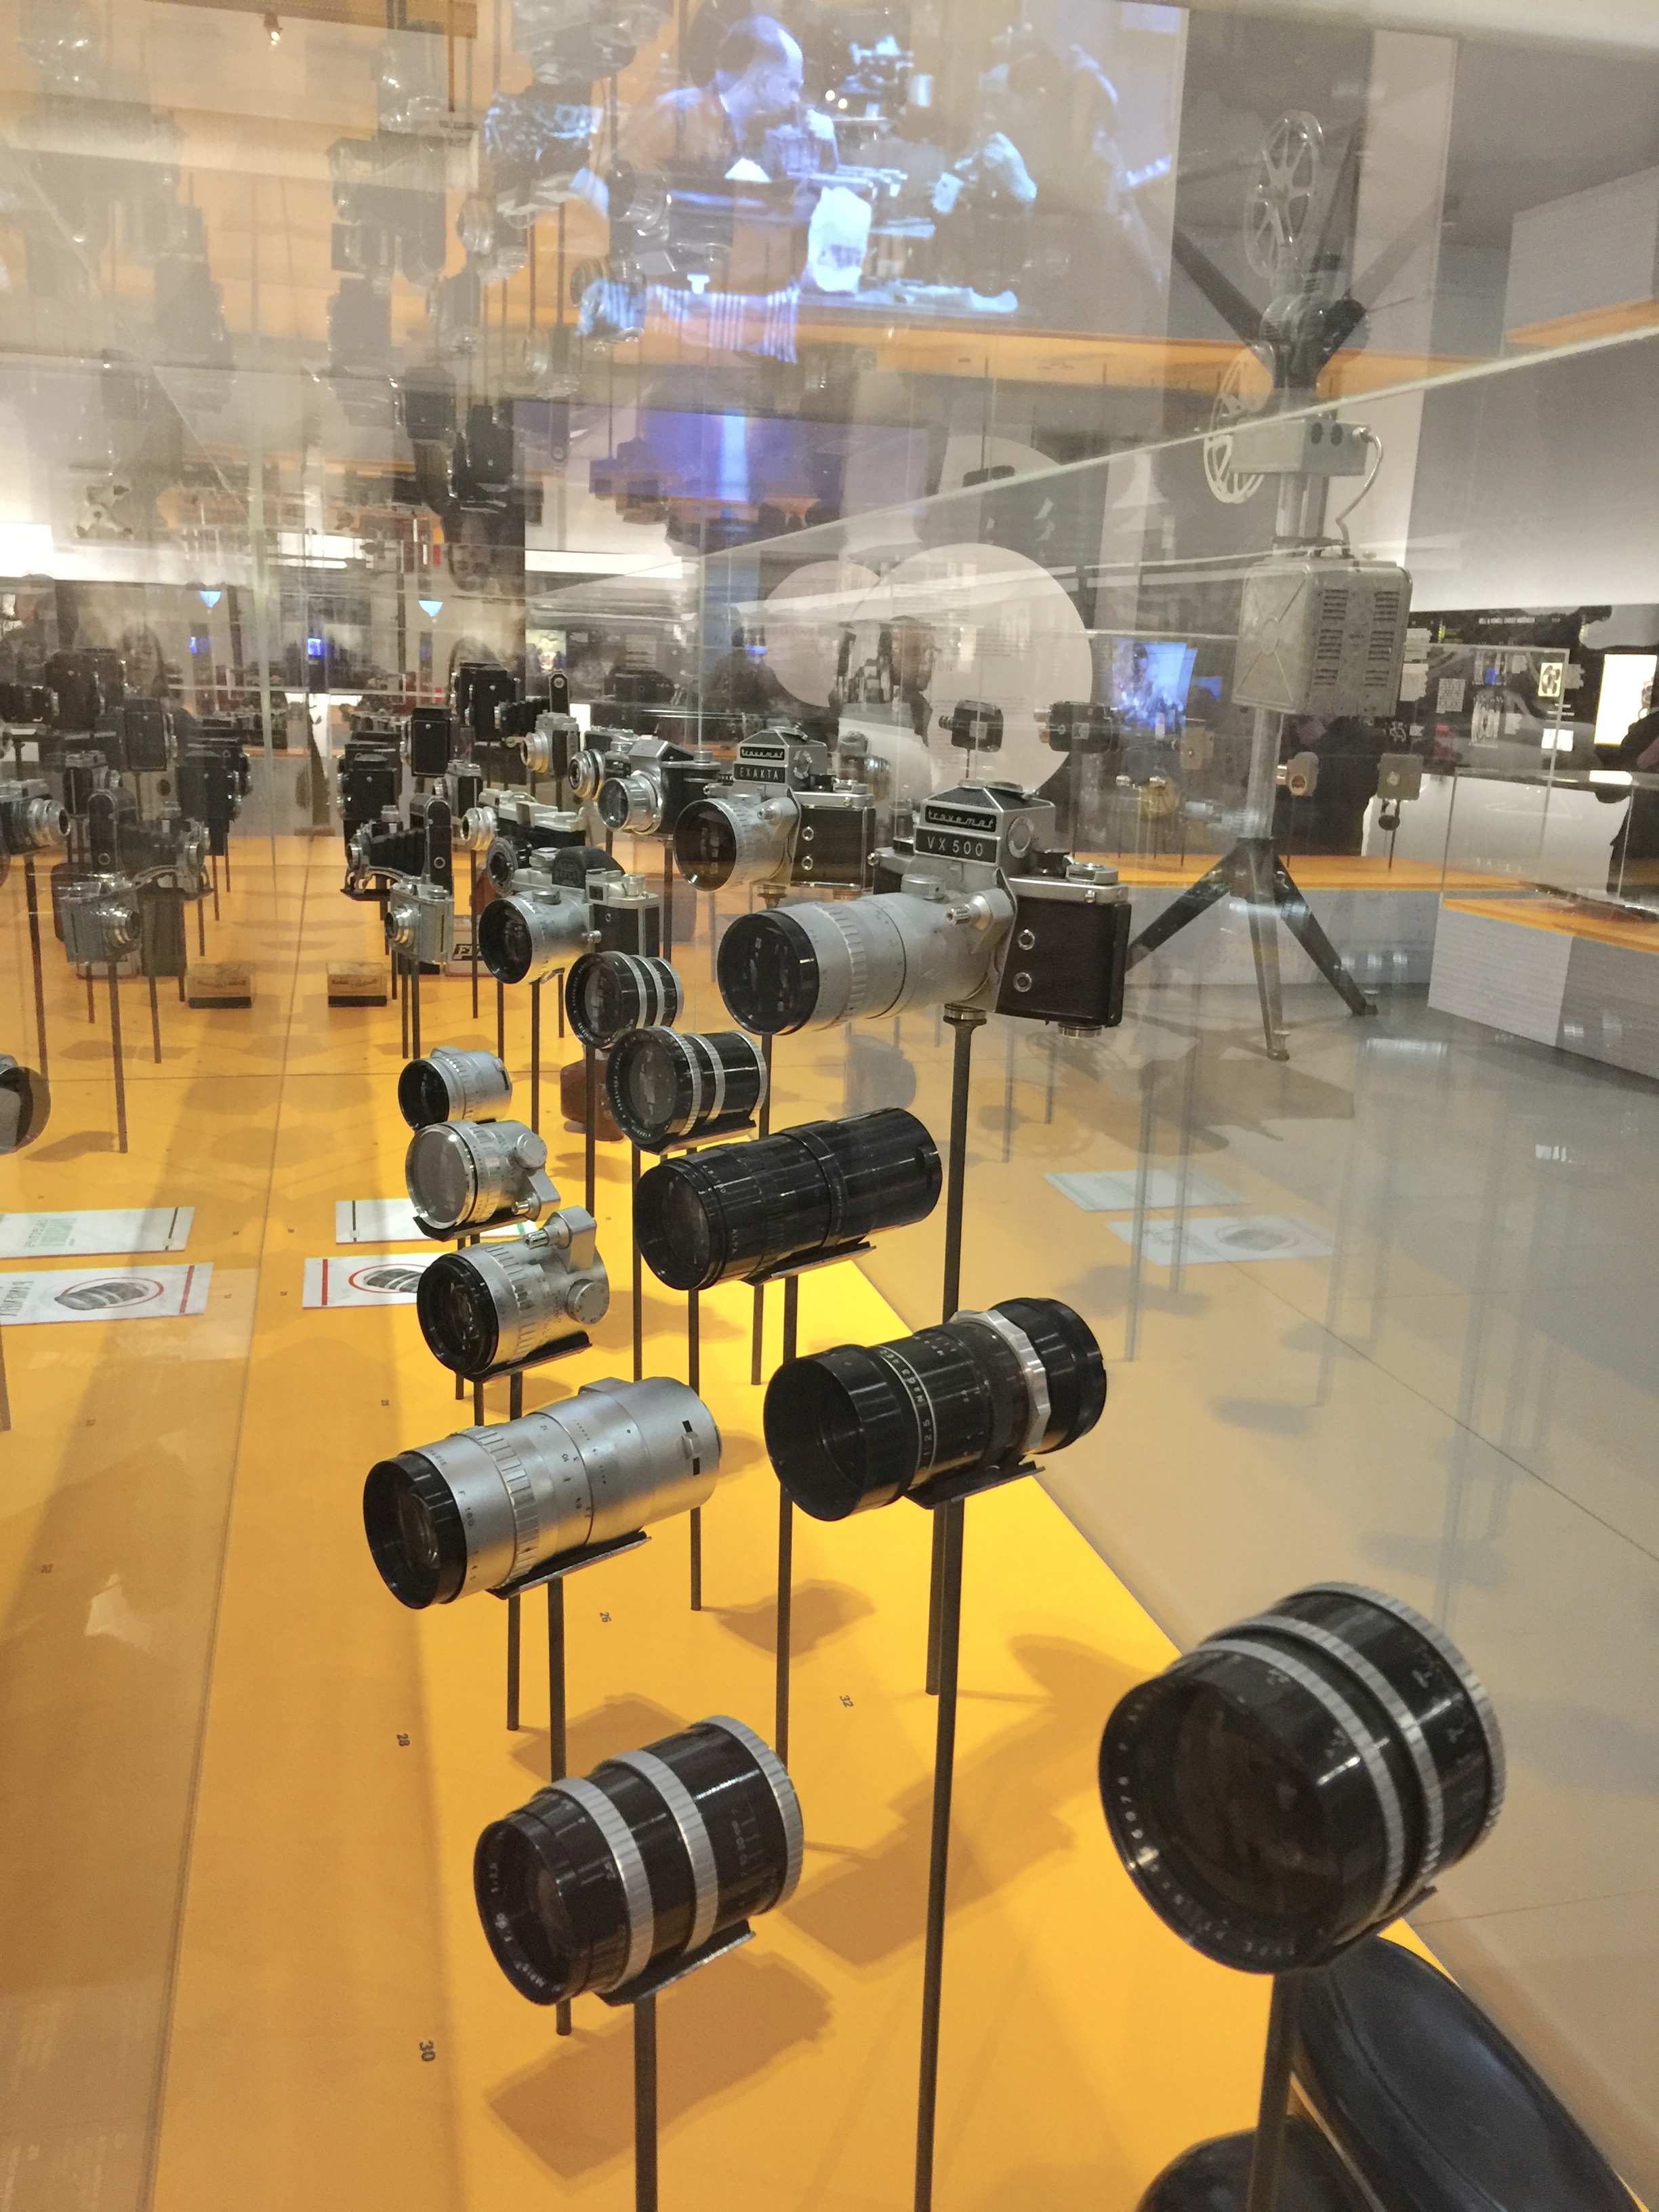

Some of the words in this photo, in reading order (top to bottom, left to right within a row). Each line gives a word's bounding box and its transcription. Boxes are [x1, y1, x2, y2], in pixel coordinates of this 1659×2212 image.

[739, 766, 779, 780] EXAKTA
[928, 810, 994, 828] travemat
[951, 840, 983, 857] 500
[599, 1612, 612, 1622] 26
[839, 1695, 854, 1708] 32
[396, 1733, 410, 1746] 28
[419, 2040, 436, 2062] 30
